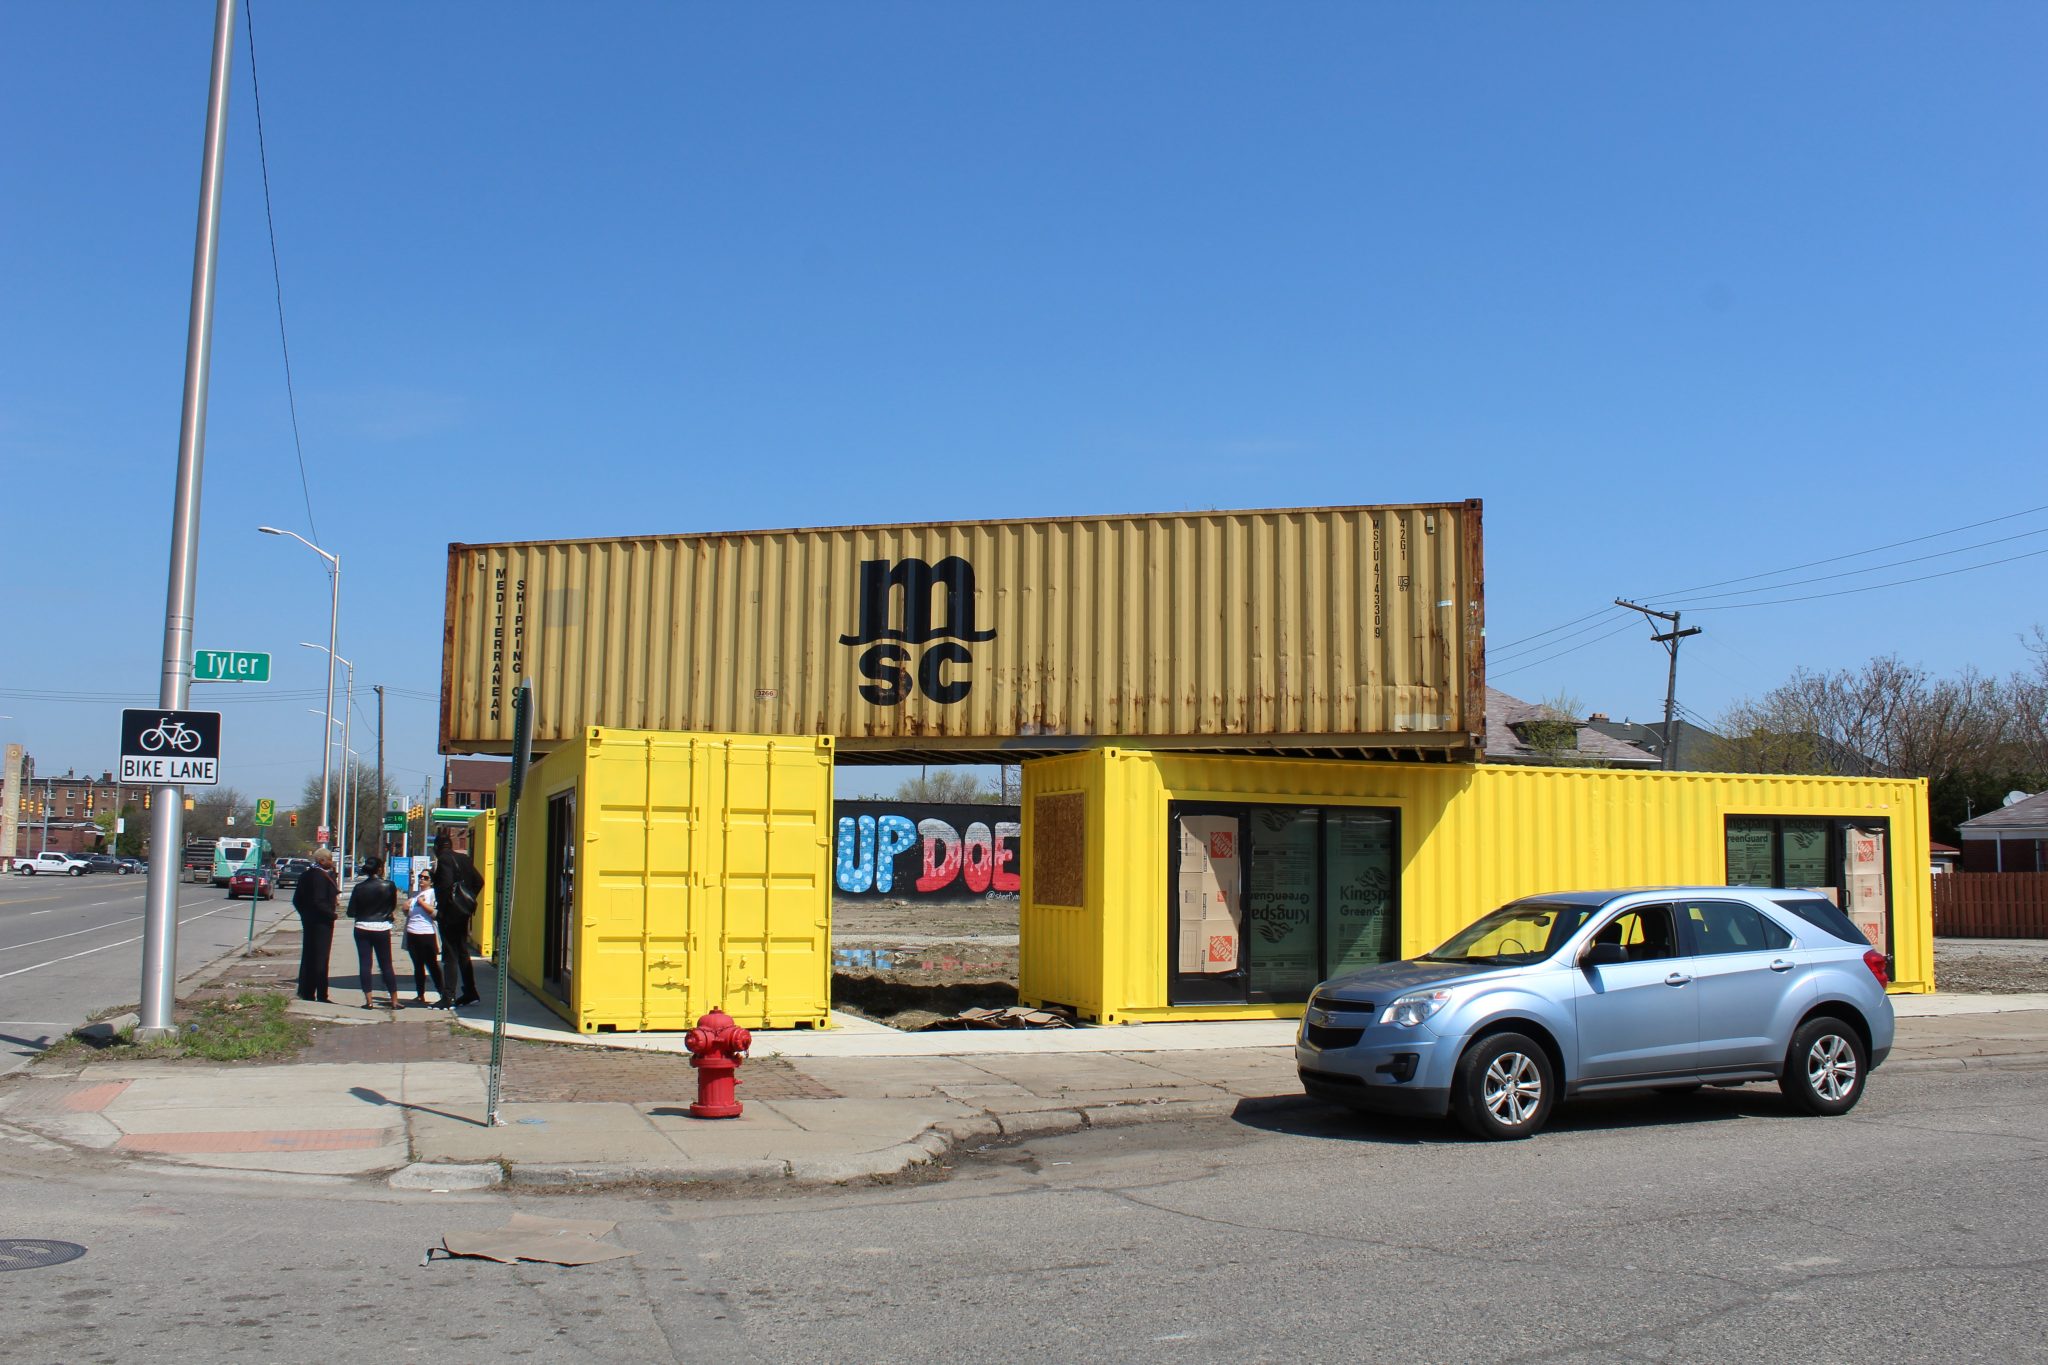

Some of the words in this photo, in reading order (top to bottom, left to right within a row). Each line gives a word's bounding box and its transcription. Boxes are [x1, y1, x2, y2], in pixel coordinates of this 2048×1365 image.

[1372, 519, 1380, 561] MSCU
[1399, 519, 1407, 561] 42G1
[491, 568, 506, 721] MEDITERRANEAN
[512, 580, 525, 674] SHIPPING
[207, 653, 259, 679] Tyler
[124, 760, 163, 778] BIKE
[170, 761, 214, 779] LANE
[835, 815, 917, 893] UP
